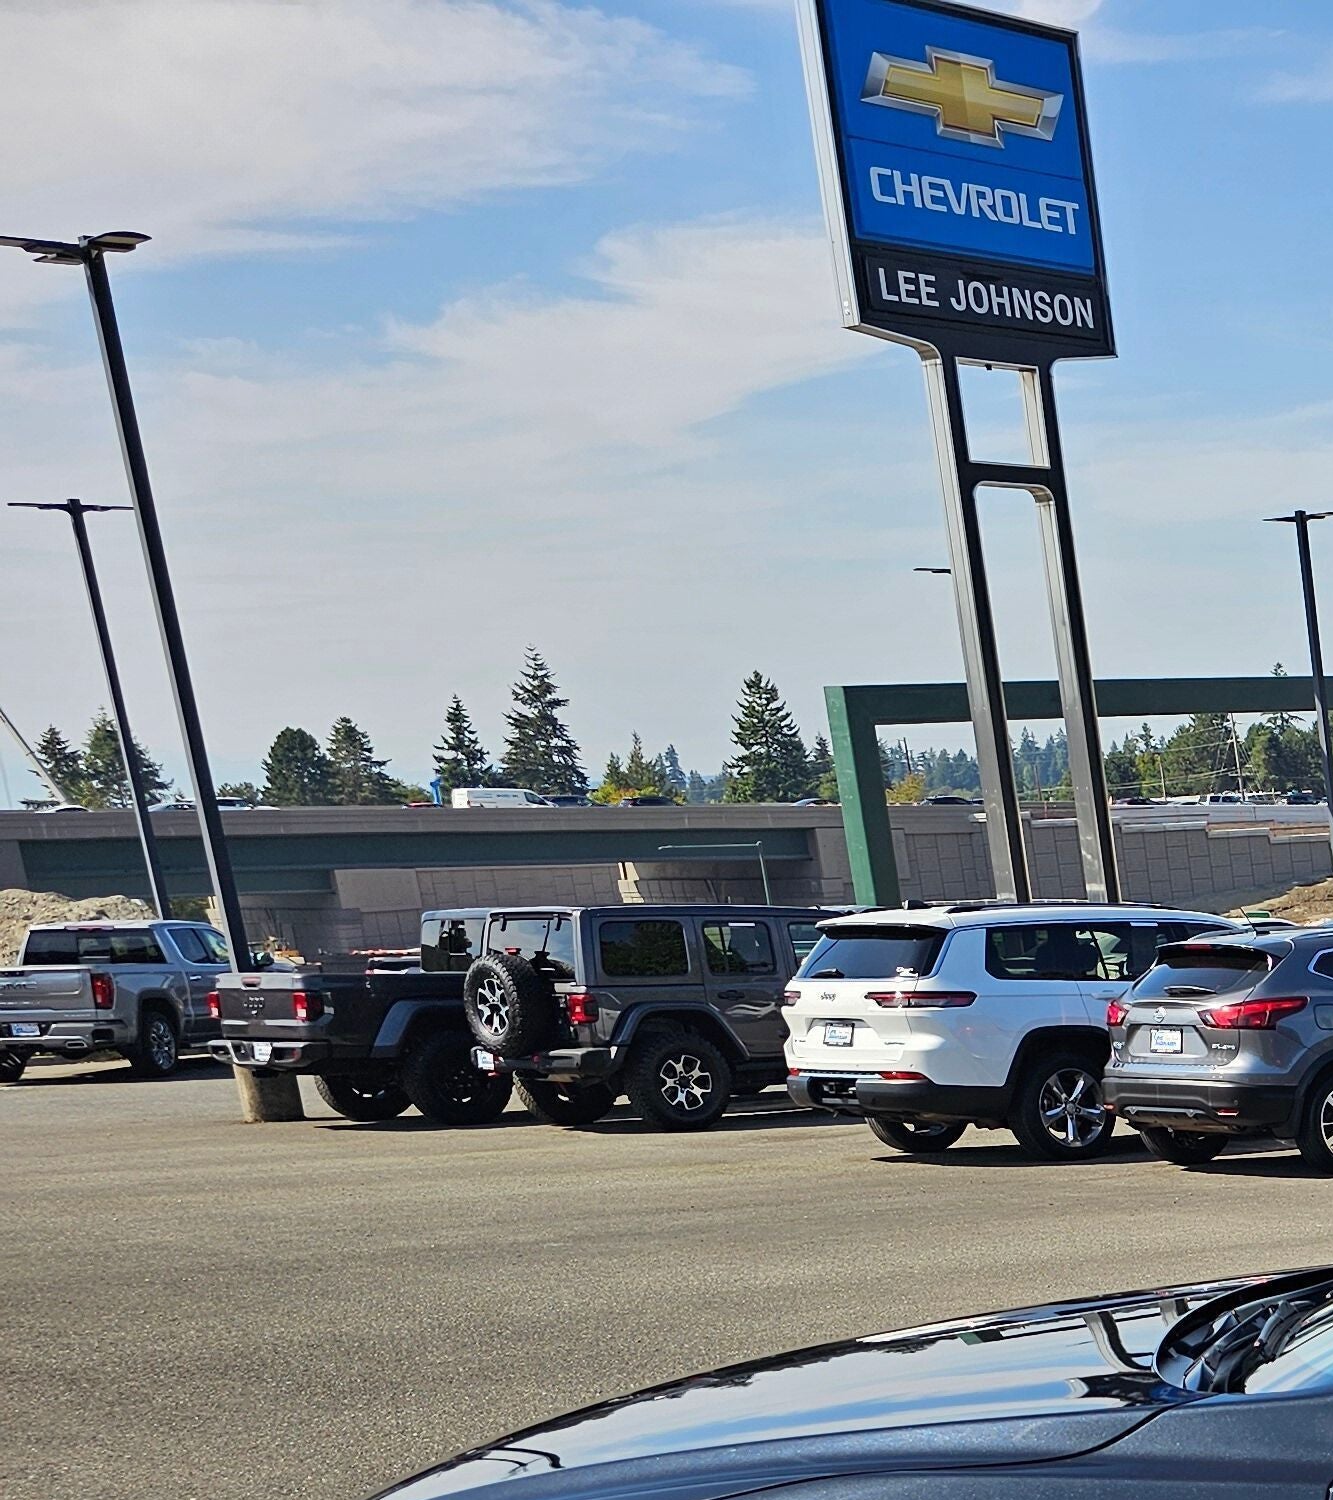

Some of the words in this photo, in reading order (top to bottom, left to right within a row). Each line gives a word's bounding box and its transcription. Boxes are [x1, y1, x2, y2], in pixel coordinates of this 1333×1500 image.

[870, 166, 1079, 235] CHEVROLET
[878, 267, 940, 307] LEE
[950, 279, 1094, 329] JOHNSON
